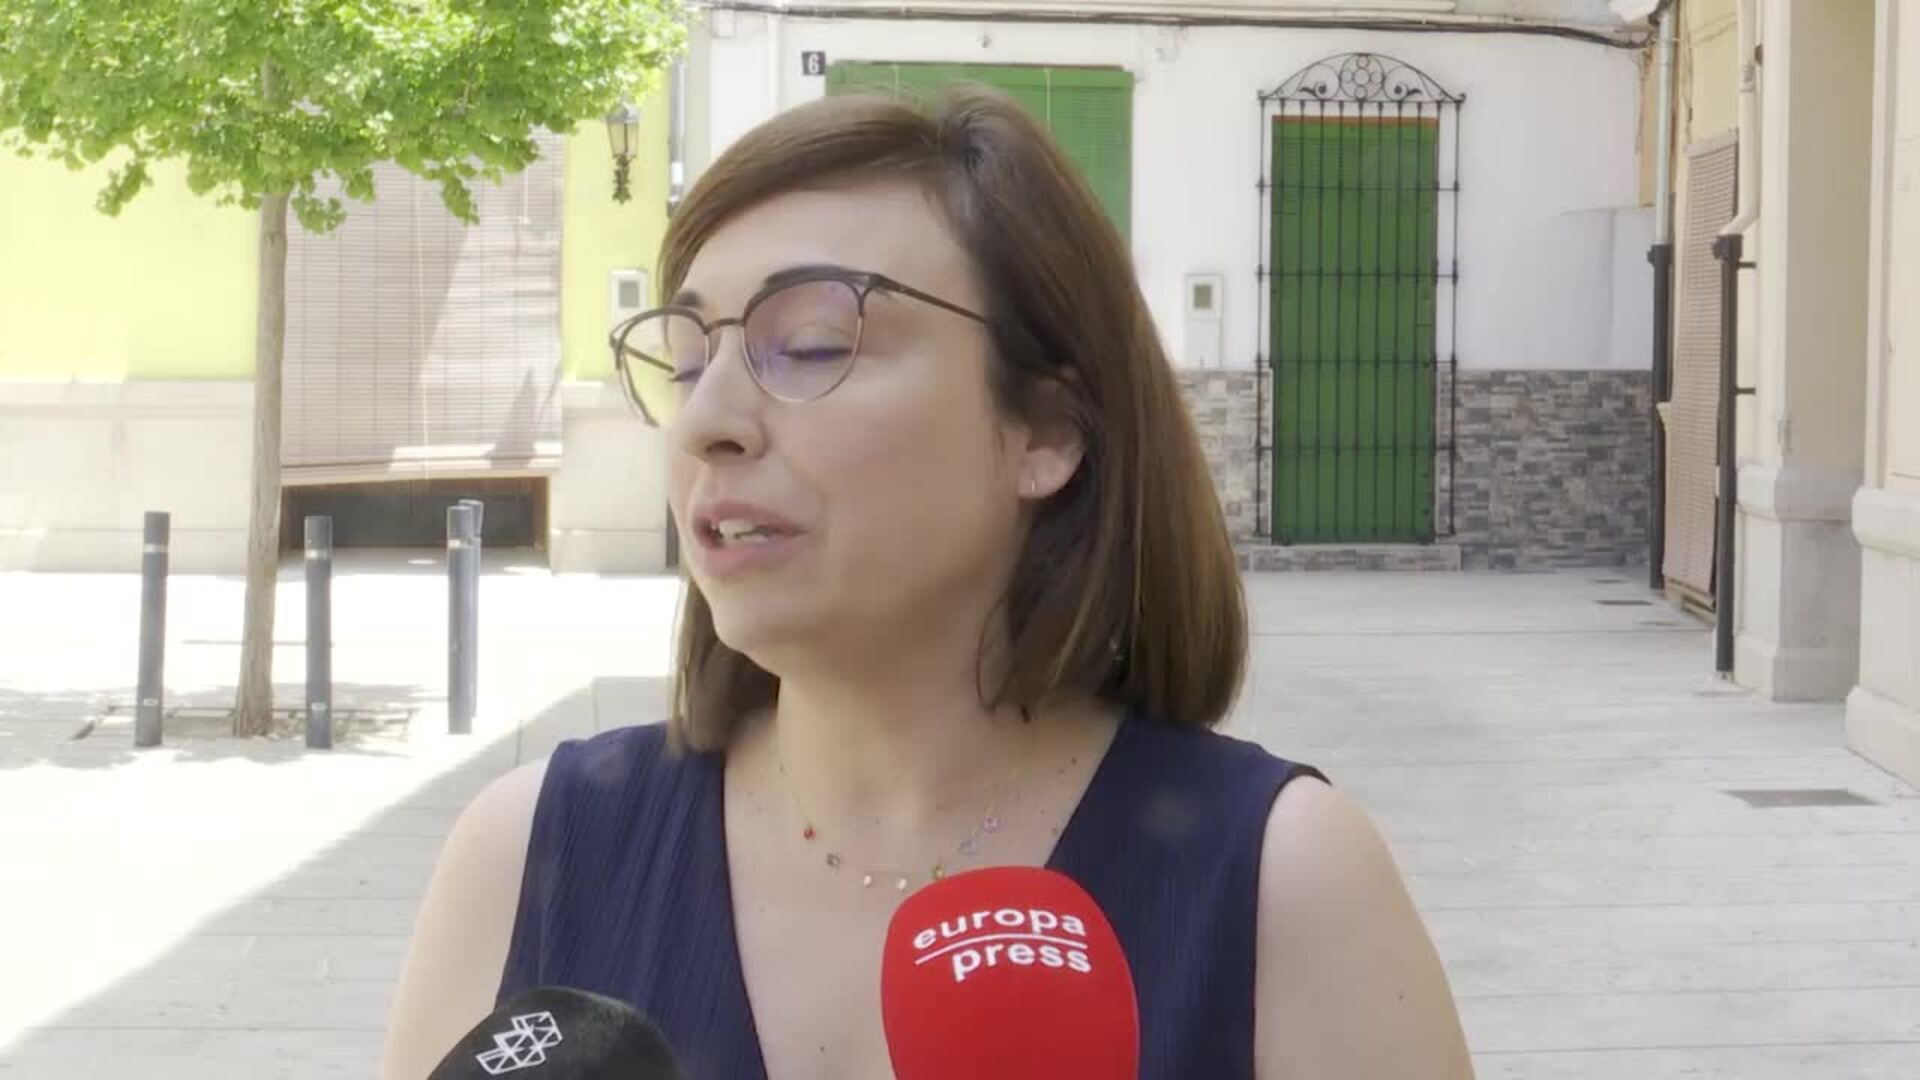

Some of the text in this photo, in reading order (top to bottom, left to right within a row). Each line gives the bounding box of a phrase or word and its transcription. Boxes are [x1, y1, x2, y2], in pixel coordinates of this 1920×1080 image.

[808, 53, 819, 74] 6
[913, 908, 1087, 949] europa
[952, 943, 1092, 983] press
